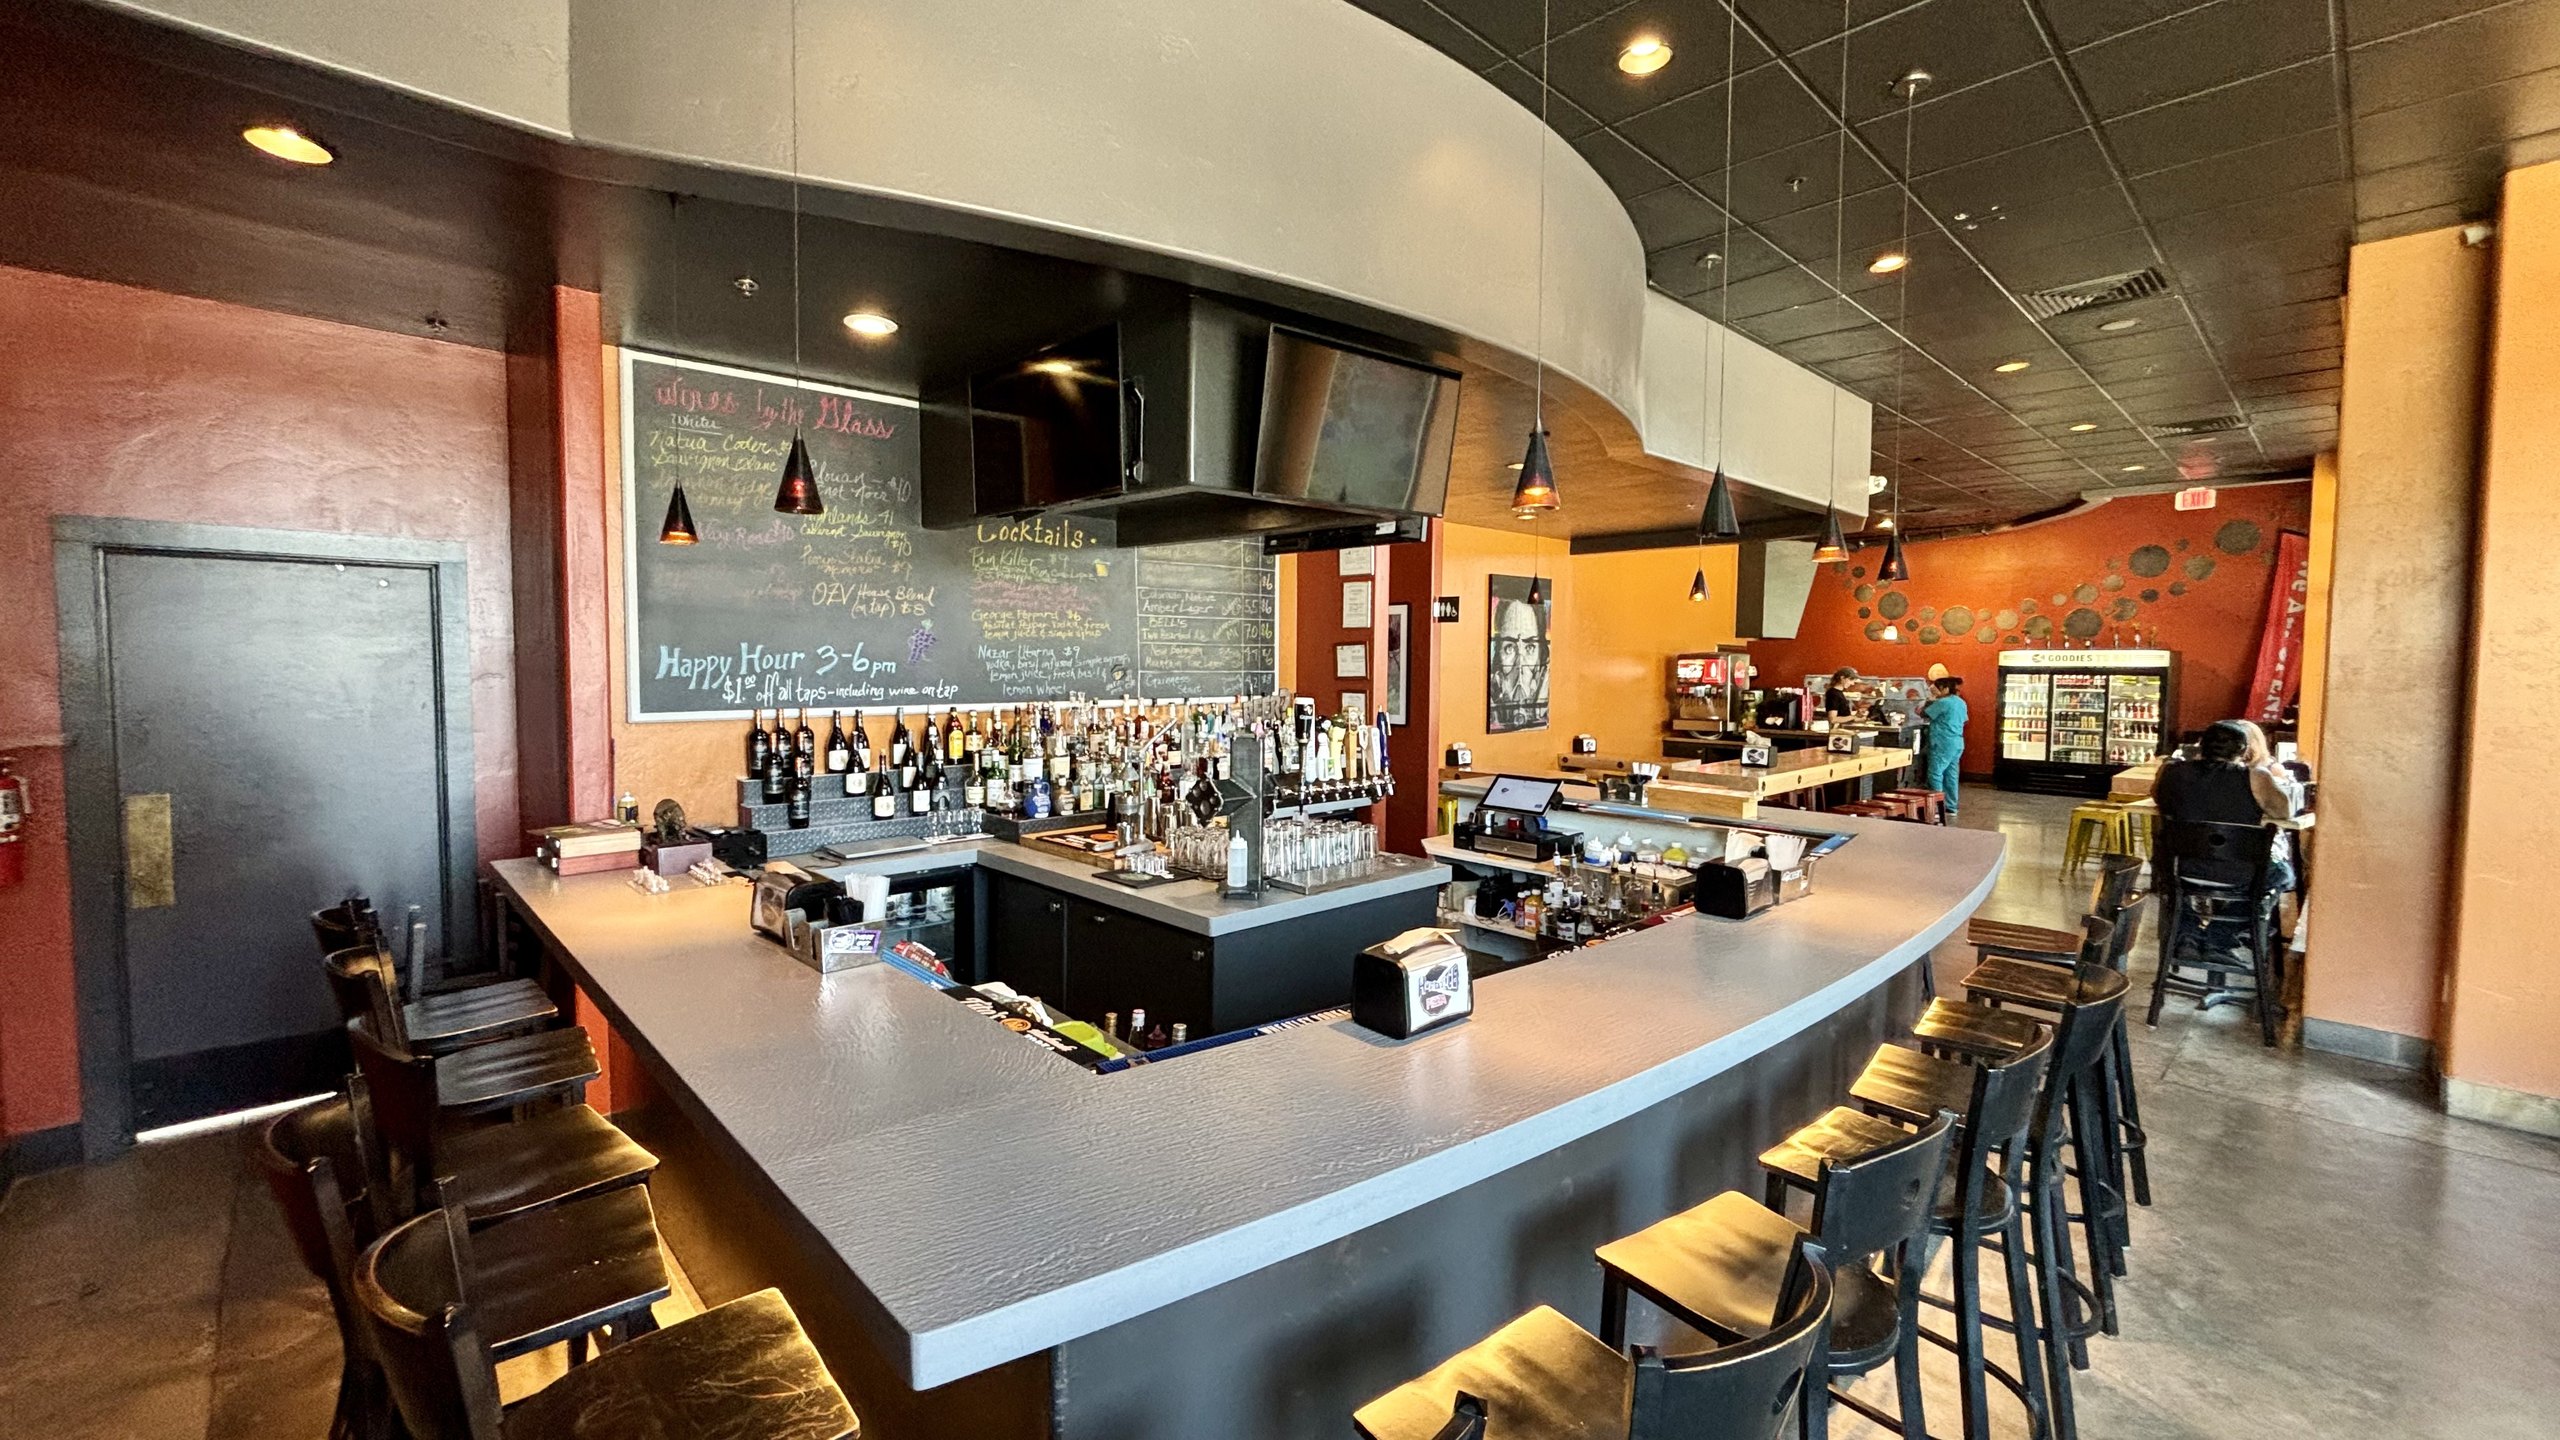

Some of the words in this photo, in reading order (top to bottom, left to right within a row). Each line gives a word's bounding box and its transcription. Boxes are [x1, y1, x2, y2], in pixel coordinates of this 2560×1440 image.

[813, 395, 895, 439] Glass
[2182, 491, 2209, 508] EXIT
[655, 644, 733, 691] Happy
[739, 641, 806, 676] Hour
[2047, 654, 2094, 662] GOODIES
